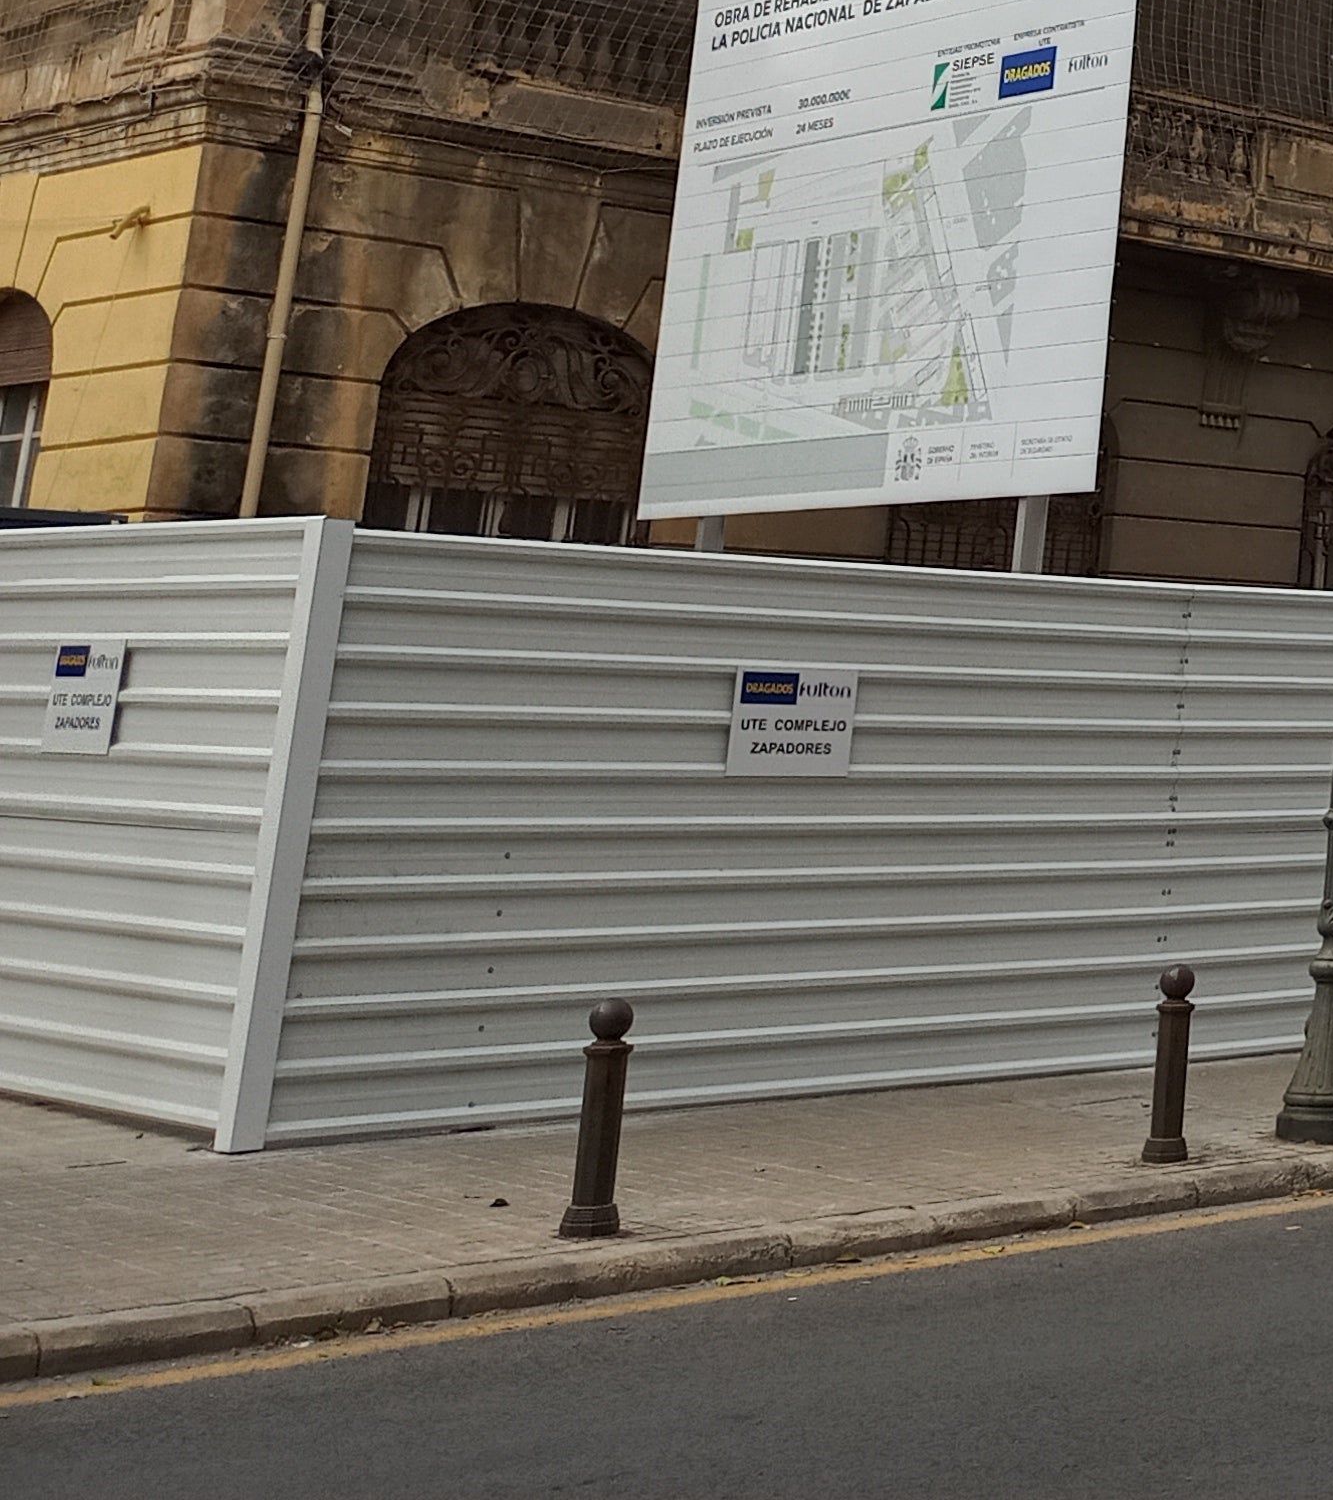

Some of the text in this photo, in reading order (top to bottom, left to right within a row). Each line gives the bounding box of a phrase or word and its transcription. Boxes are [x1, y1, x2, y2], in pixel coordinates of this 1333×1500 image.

[714, 4, 750, 28] OBRA
[753, 0, 771, 18] DE
[711, 33, 728, 51] LA
[730, 21, 781, 47] POLICIA
[784, 3, 855, 34] NACIONAL
[951, 52, 995, 72] SIEPSE
[1003, 61, 1051, 84] DRAGADOS
[735, 104, 772, 121] PREVISTA
[806, 117, 834, 133] MESES
[693, 138, 718, 153] PLAZO
[719, 135, 731, 148] DE
[746, 683, 794, 694] DRAGADOS
[741, 719, 847, 731] UTE COMPLEJO
[750, 741, 832, 755] ZAPADORES
